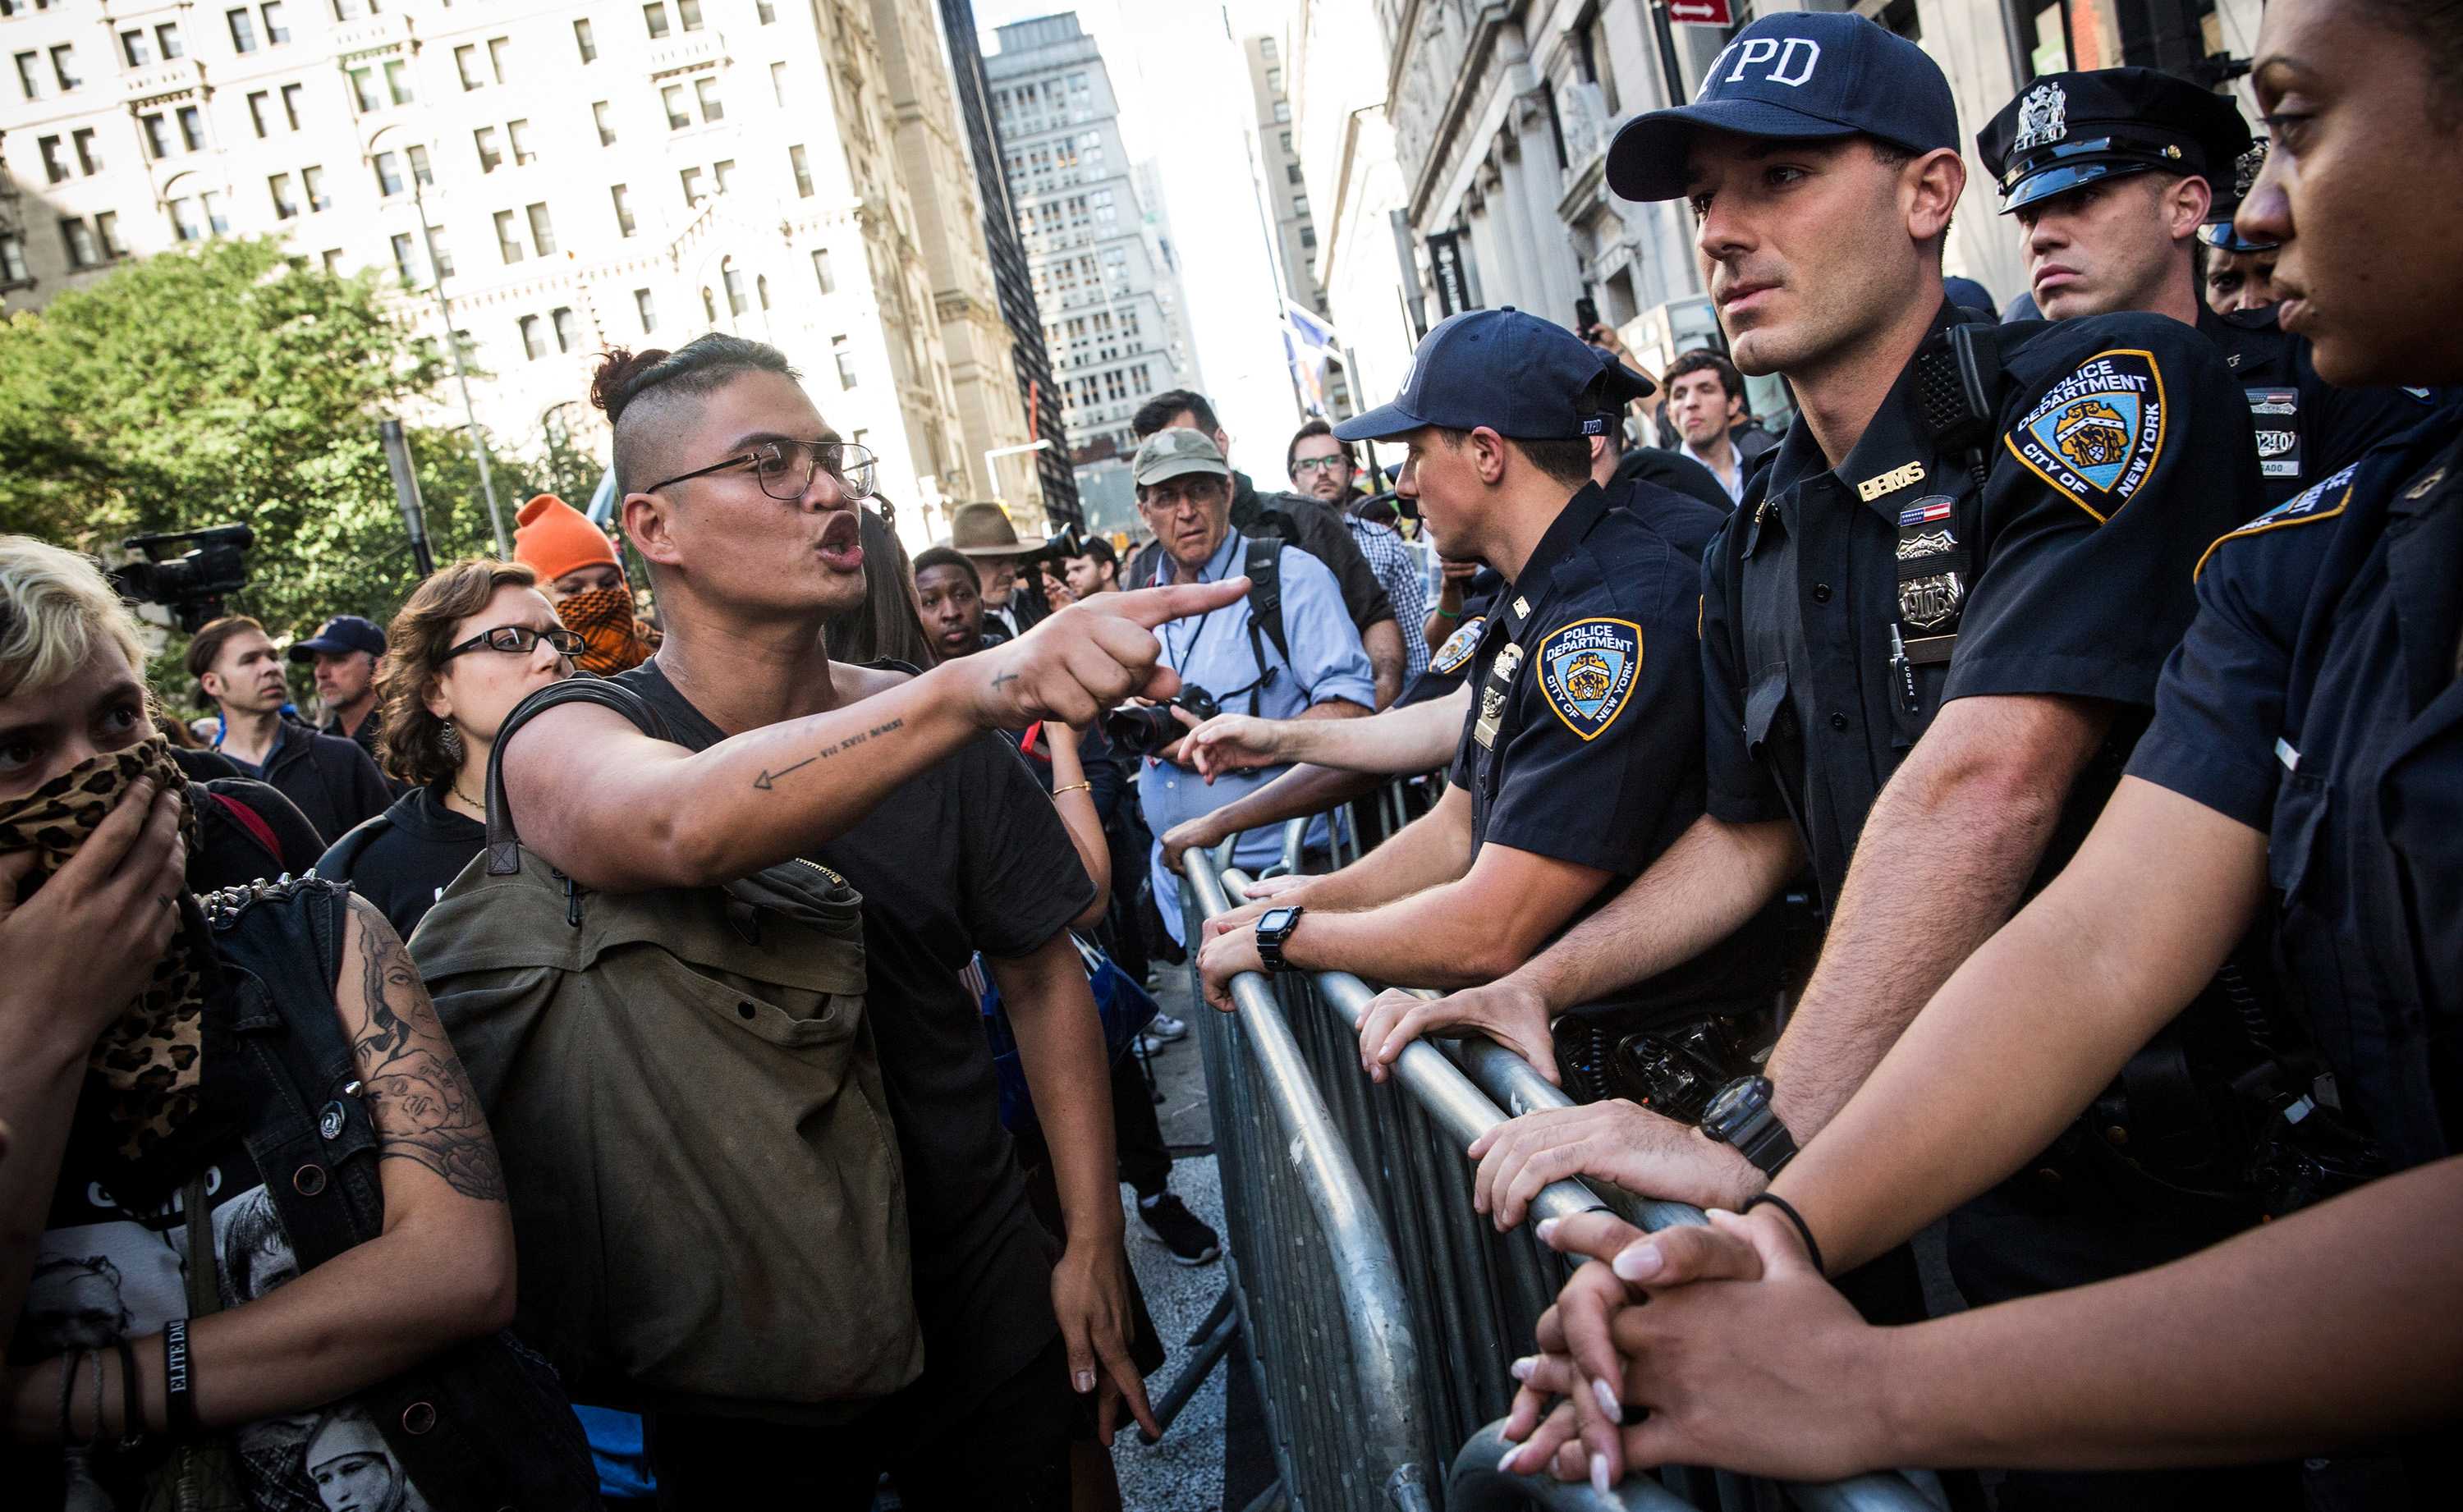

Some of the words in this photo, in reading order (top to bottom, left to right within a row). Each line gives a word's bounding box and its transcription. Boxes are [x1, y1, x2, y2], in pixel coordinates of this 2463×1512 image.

[2017, 374, 2148, 432] DEPARTMENT
[2041, 360, 2114, 403] POLICE
[1581, 419, 1603, 434] NYPD
[2023, 442, 2062, 474] CITY
[2059, 472, 2089, 494] OF
[2117, 456, 2148, 498] NEW
[2139, 403, 2160, 455] YORK
[1546, 637, 1634, 662] DEPARTMENT
[1563, 625, 1613, 643] POLICE
[1547, 674, 1566, 702] CITY
[1562, 702, 1580, 719] OF
[1595, 696, 1618, 722] NEW
[1613, 660, 1635, 694] YORK
[1905, 666, 1915, 696] COBRA
[169, 1343, 186, 1393] ELITE
